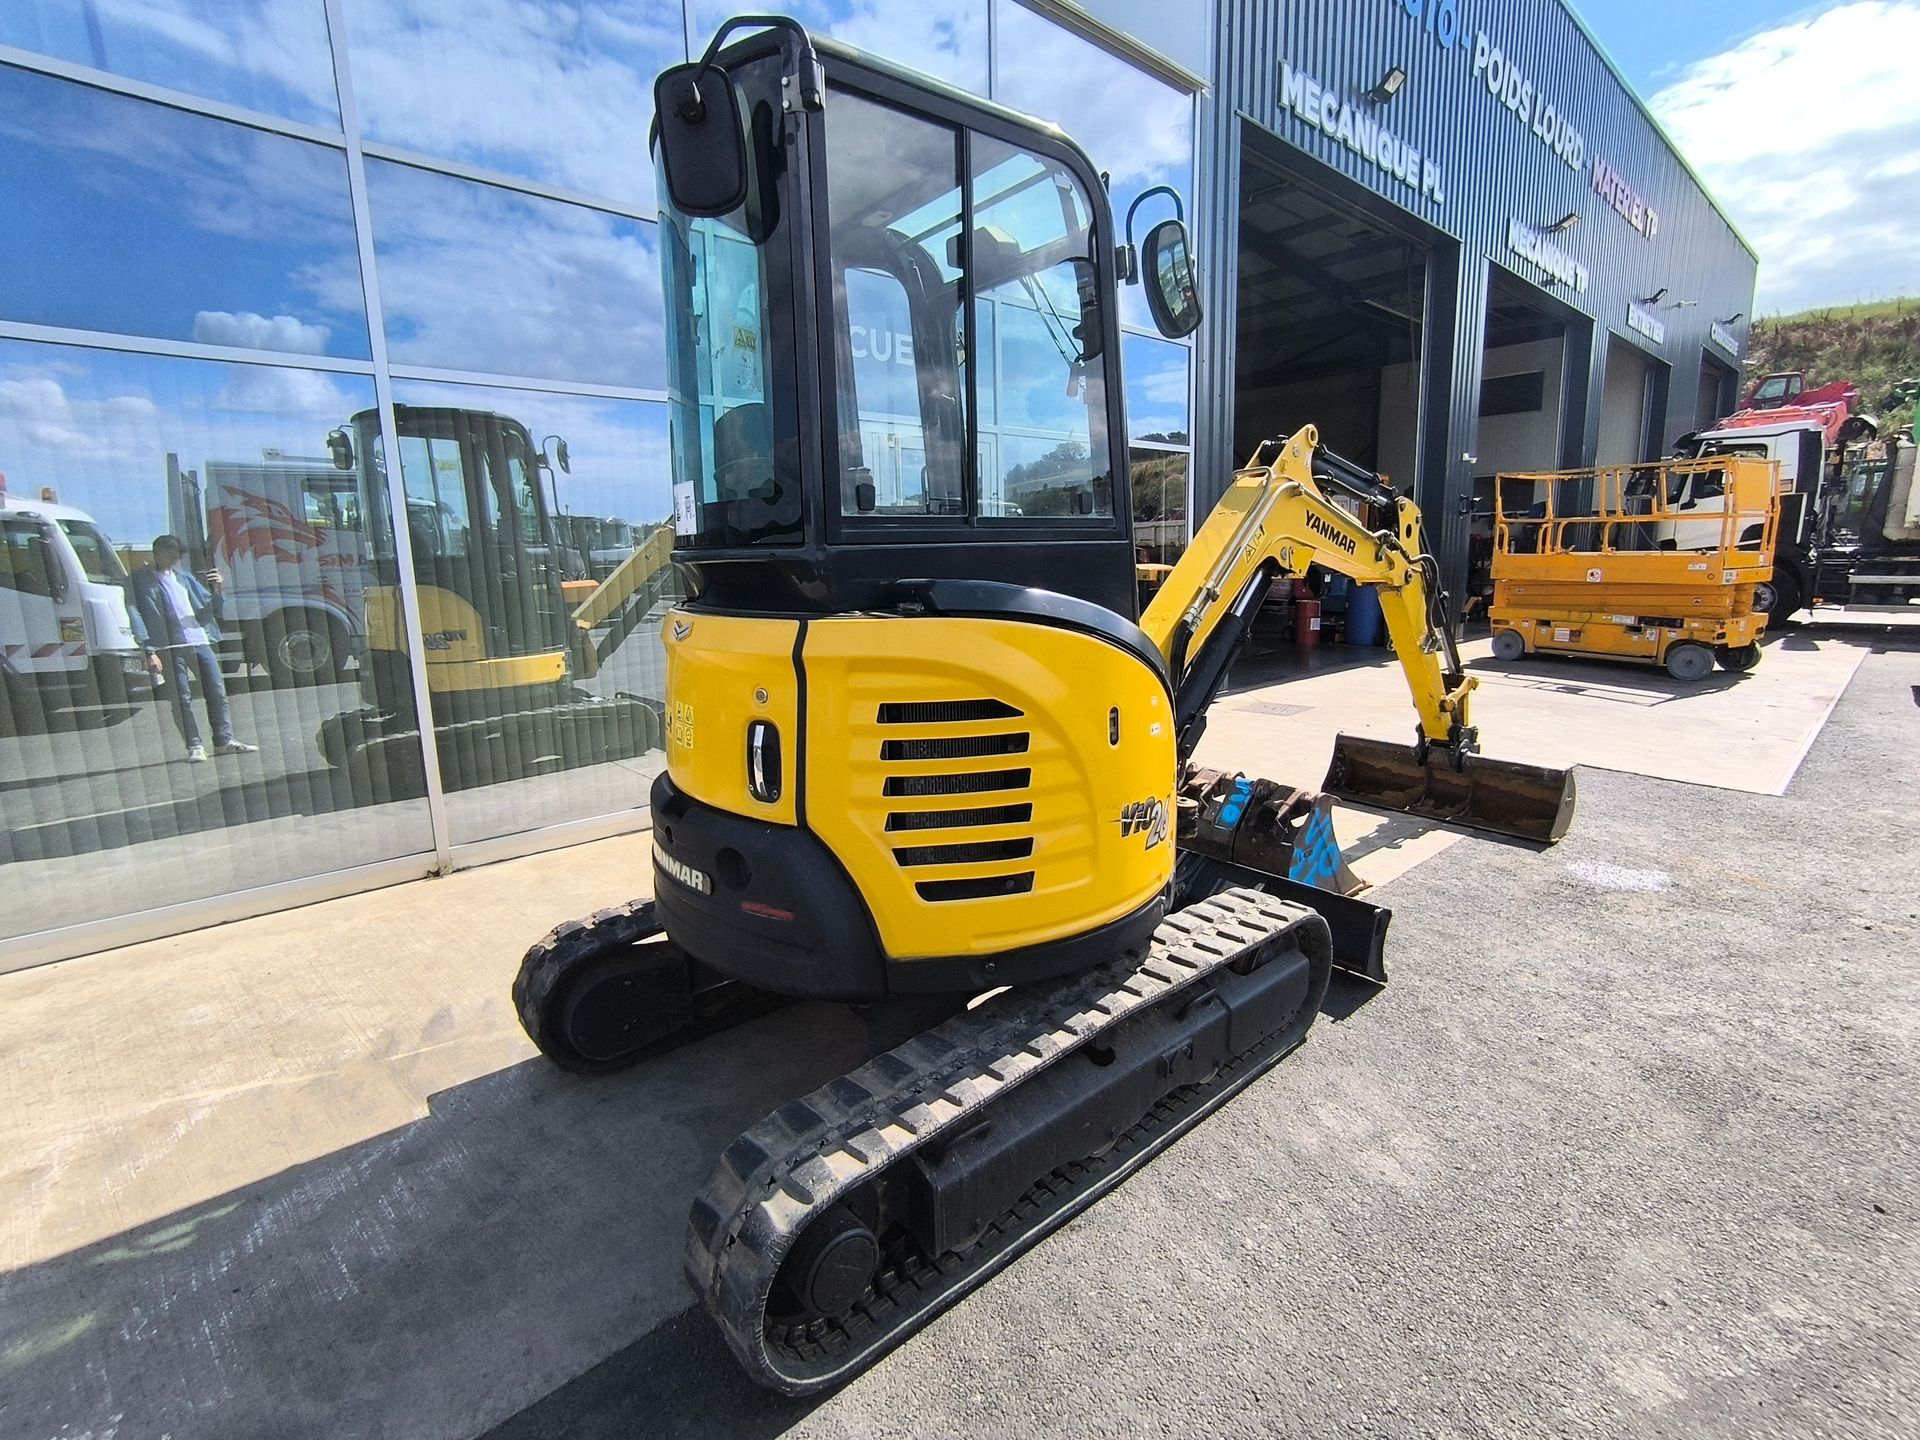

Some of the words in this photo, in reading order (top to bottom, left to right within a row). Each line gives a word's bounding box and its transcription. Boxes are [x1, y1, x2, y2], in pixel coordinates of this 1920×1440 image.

[1280, 61, 1422, 190] MECANIQUE
[1422, 154, 1444, 205] PL
[1473, 30, 1533, 123] POIDS
[1532, 92, 1583, 171] LOURD
[1590, 152, 1642, 232] MATERIEL
[1508, 215, 1576, 287] MECANIQUE
[1305, 509, 1356, 555] YANMAR
